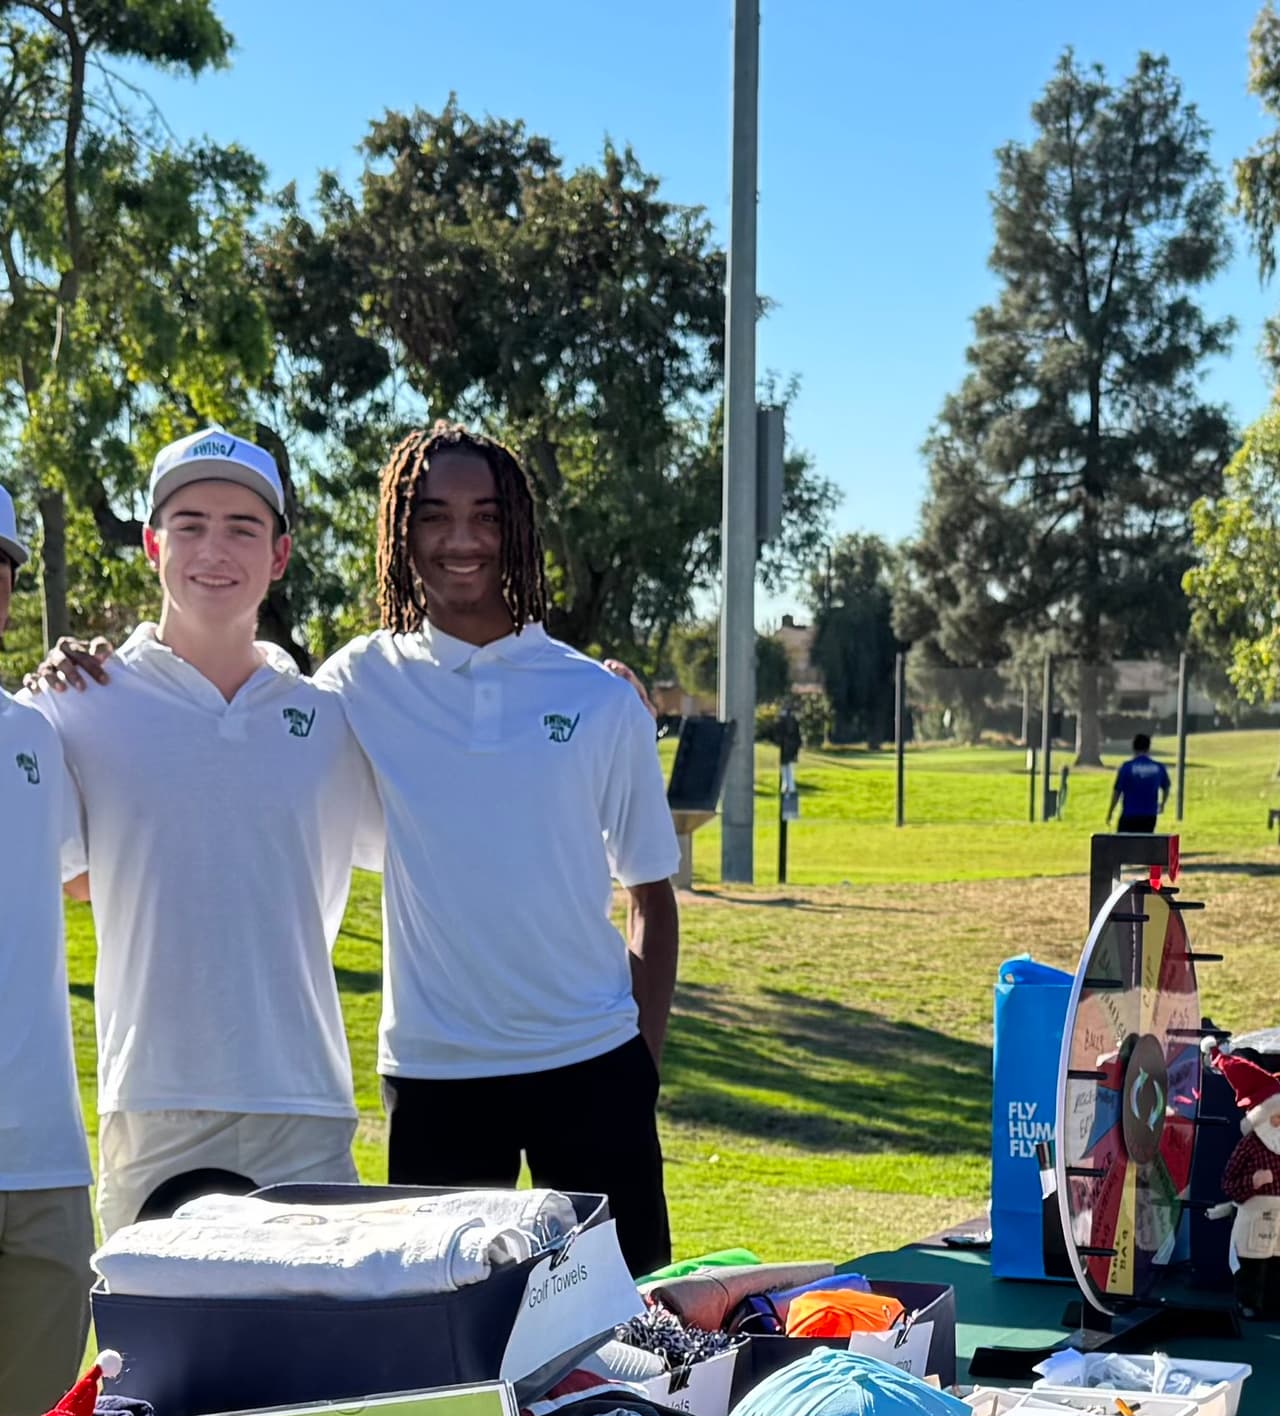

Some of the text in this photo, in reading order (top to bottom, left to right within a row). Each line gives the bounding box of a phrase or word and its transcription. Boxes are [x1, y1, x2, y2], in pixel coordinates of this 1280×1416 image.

[1008, 1101, 1037, 1120] FLY
[527, 1262, 588, 1309] Golf Towels
